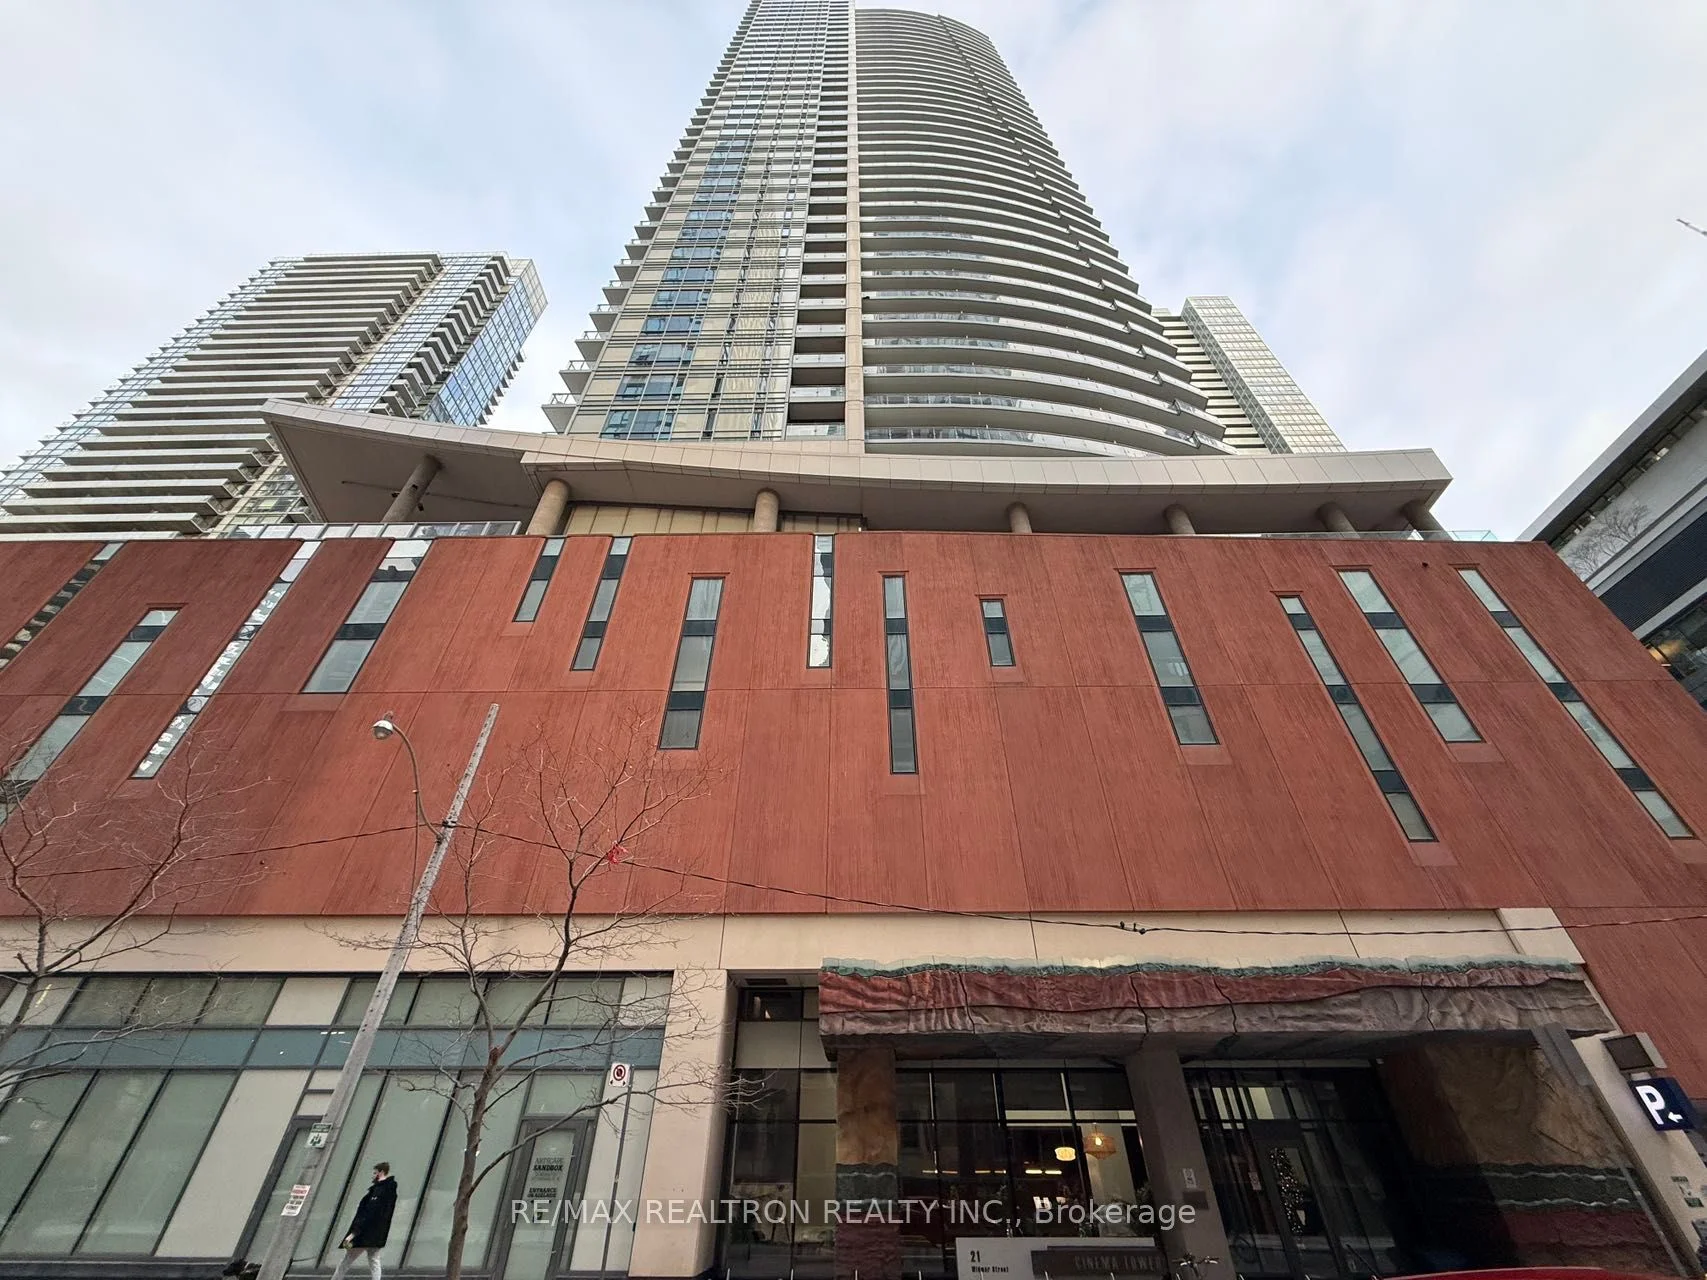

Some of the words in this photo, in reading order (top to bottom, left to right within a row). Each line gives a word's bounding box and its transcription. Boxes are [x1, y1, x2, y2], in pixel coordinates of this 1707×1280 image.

[1636, 1085, 1665, 1124] P
[970, 1250, 981, 1263] 21
[1074, 1255, 1119, 1270] CINEMA
